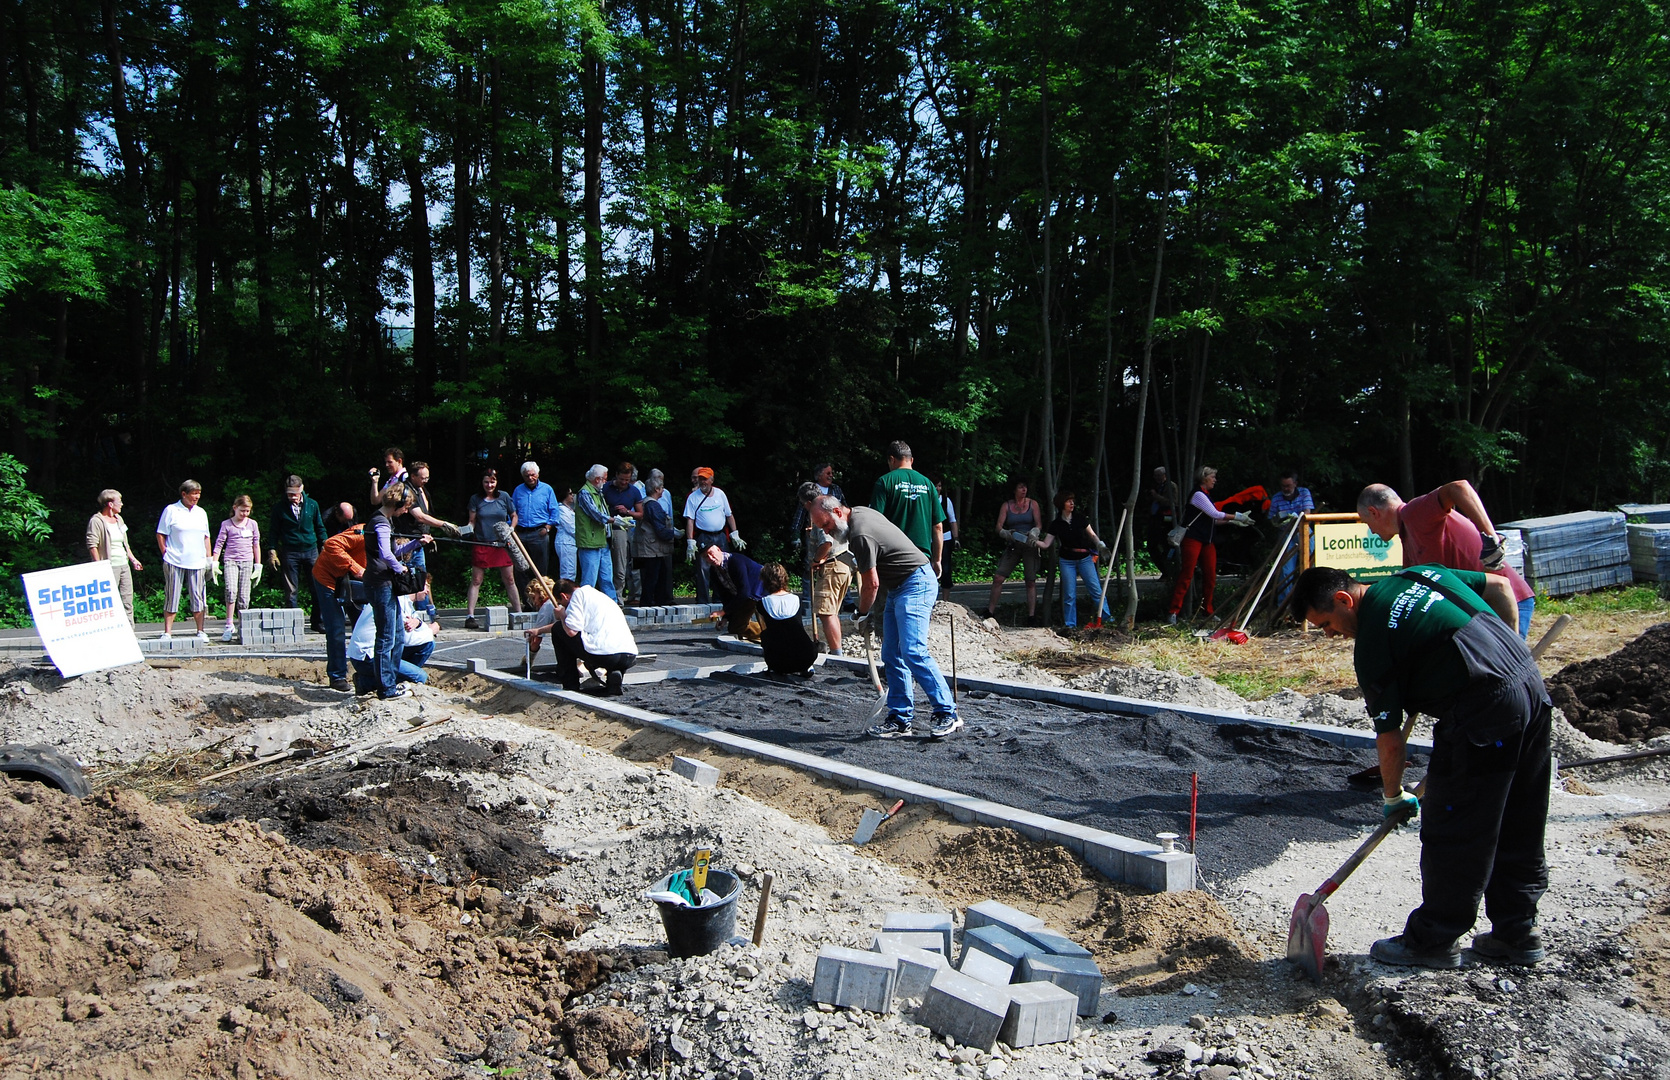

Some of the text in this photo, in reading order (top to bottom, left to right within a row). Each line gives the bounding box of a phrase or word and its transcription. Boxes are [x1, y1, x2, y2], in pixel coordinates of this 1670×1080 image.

[38, 579, 111, 605] Schade
[63, 596, 113, 617] Sohn
[65, 609, 115, 627] BAUSTOFFE
[1388, 593, 1412, 629] grünen
